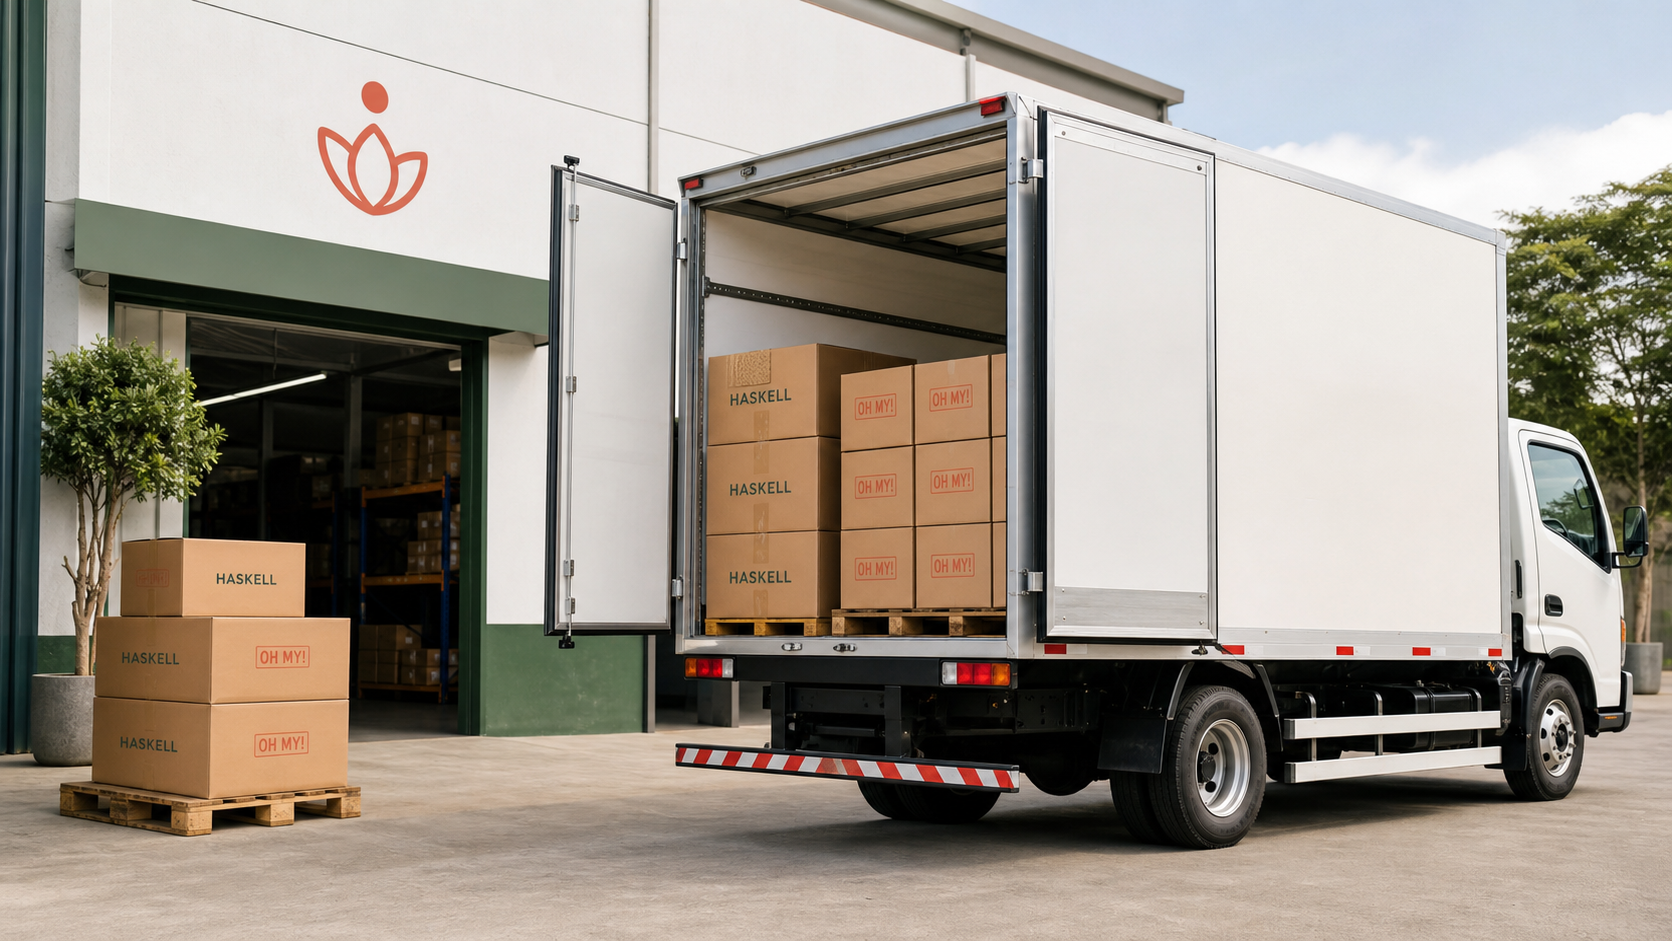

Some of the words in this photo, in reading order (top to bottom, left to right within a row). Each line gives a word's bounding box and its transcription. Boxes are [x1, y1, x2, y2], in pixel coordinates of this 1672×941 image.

[729, 388, 792, 406] HASKELL
[932, 391, 947, 407] OH
[950, 388, 970, 405] MY!
[857, 401, 872, 415] OH
[875, 398, 894, 414] MY!
[729, 481, 792, 496] HASKELL
[857, 480, 872, 495] OH
[875, 478, 894, 493] MY!
[933, 474, 948, 489] OH
[951, 472, 971, 488] MY!
[857, 562, 872, 576] OH
[875, 560, 894, 575] MY!
[934, 559, 948, 573] OH
[952, 557, 972, 572] MY!
[216, 573, 277, 586] HASKELL
[729, 570, 792, 584] HASKELL
[121, 652, 180, 665] HASKELL
[260, 650, 278, 665] OH
[282, 650, 306, 664] MY!
[120, 736, 178, 753] HASKELL
[258, 738, 277, 753] OH
[281, 736, 305, 751] MY!
